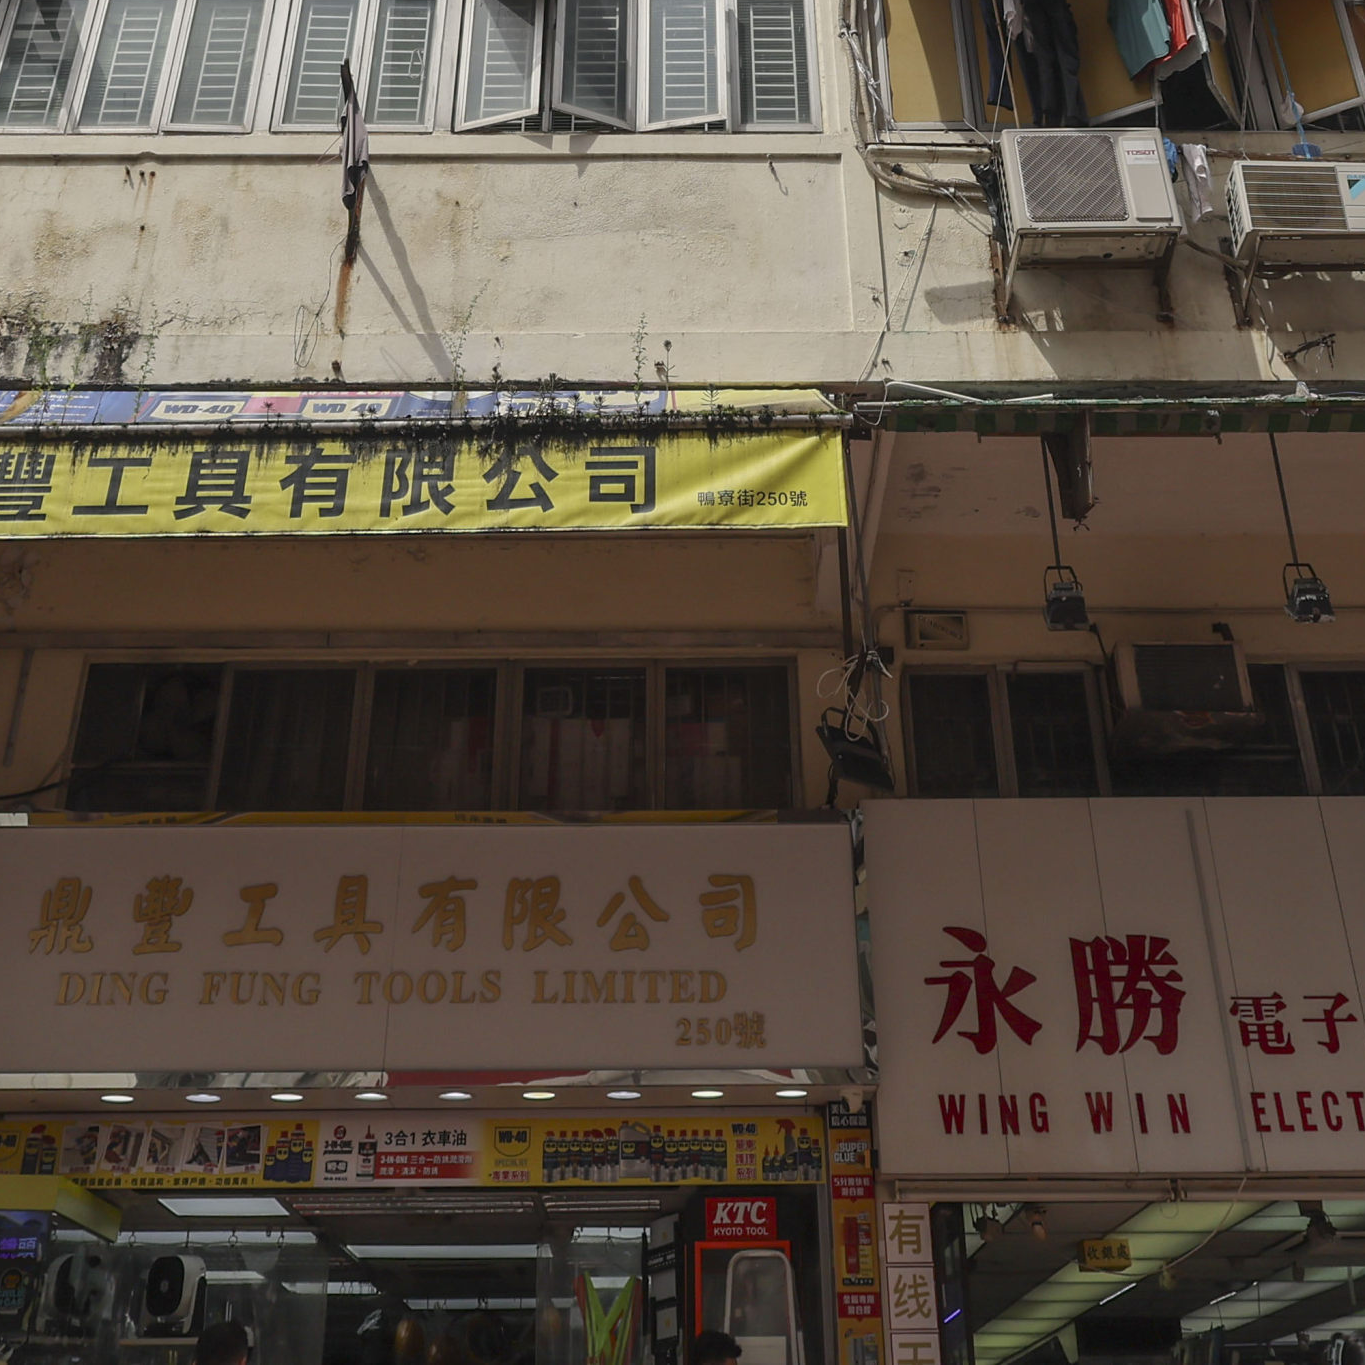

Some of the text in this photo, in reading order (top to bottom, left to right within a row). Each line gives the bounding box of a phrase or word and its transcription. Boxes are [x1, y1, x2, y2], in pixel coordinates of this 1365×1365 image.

[163, 403, 235, 416] WD-40
[696, 489, 809, 509] 鴨寮街250號
[28, 874, 758, 956] 鼎豐工具有限公司
[55, 969, 729, 1007] DING FUNG TOOLS LIMITED
[923, 925, 1187, 1056] 永勝
[675, 1011, 768, 1050] 250號
[938, 1092, 1050, 1136] WING
[1085, 1091, 1192, 1135] WIN
[384, 1129, 467, 1147] 3合1 衣車油
[498, 1130, 528, 1143] WD-40
[712, 1201, 769, 1224] KTC
[713, 1226, 770, 1237] KYOTO TOOL
